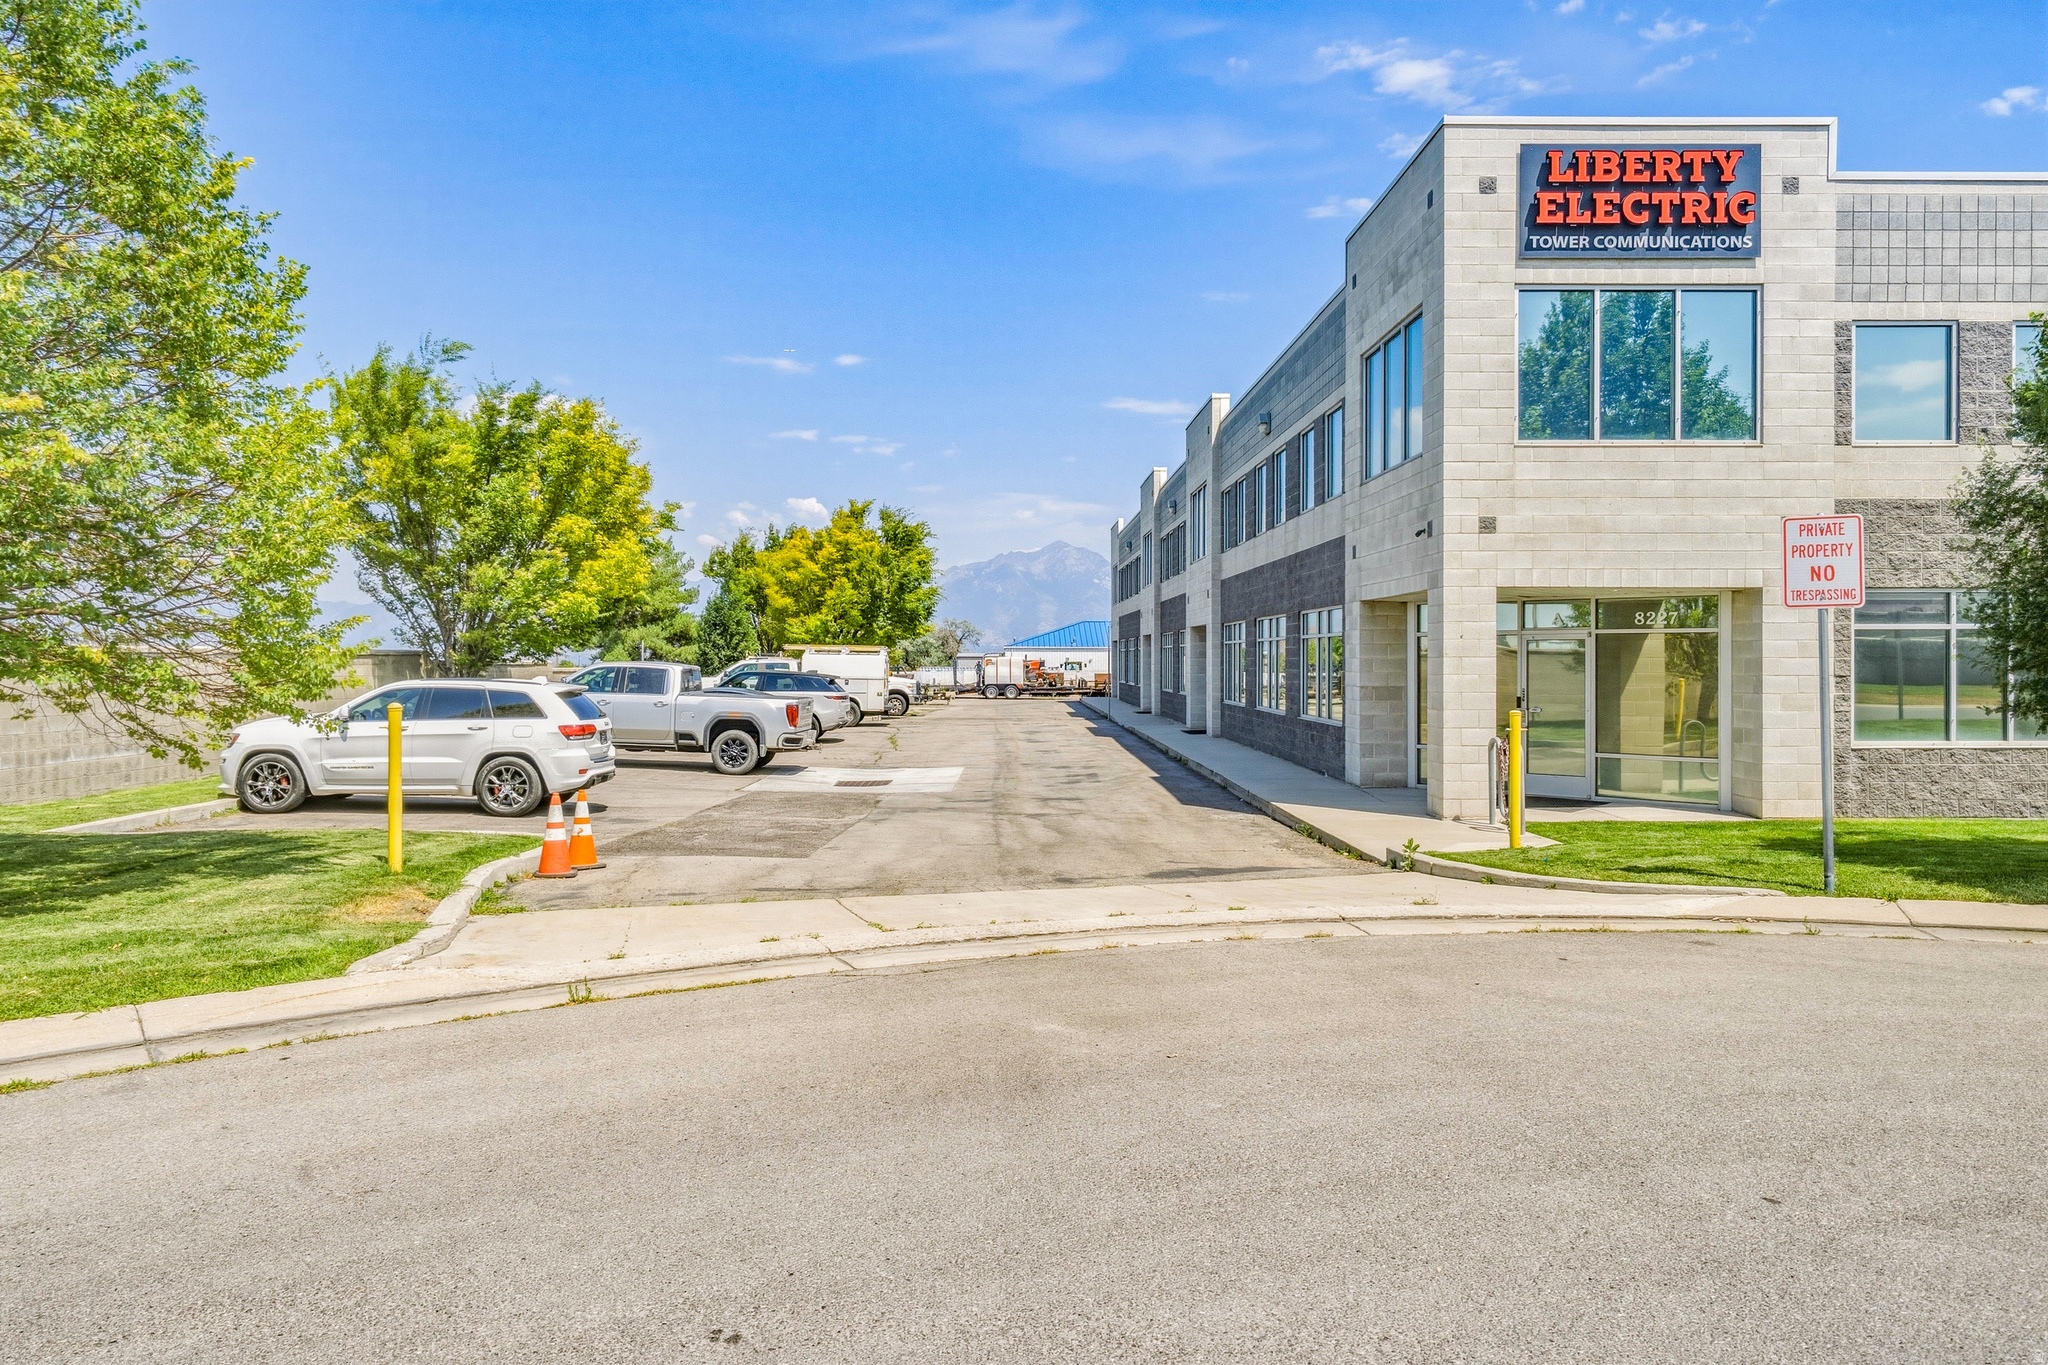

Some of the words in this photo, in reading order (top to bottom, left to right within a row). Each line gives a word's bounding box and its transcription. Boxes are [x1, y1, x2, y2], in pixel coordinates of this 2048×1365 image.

[1547, 150, 1744, 183] LIBERTY
[1535, 191, 1756, 225] ELECTRIC
[1529, 235, 1590, 249] TOWER
[1593, 234, 1753, 249] COMMUNICATIONS
[1799, 522, 1845, 537] PRIVATE
[1791, 543, 1853, 558] PROPERTY
[1810, 564, 1836, 582] NO
[1790, 588, 1857, 601] TRESPASSING
[1634, 611, 1679, 625] 8227
